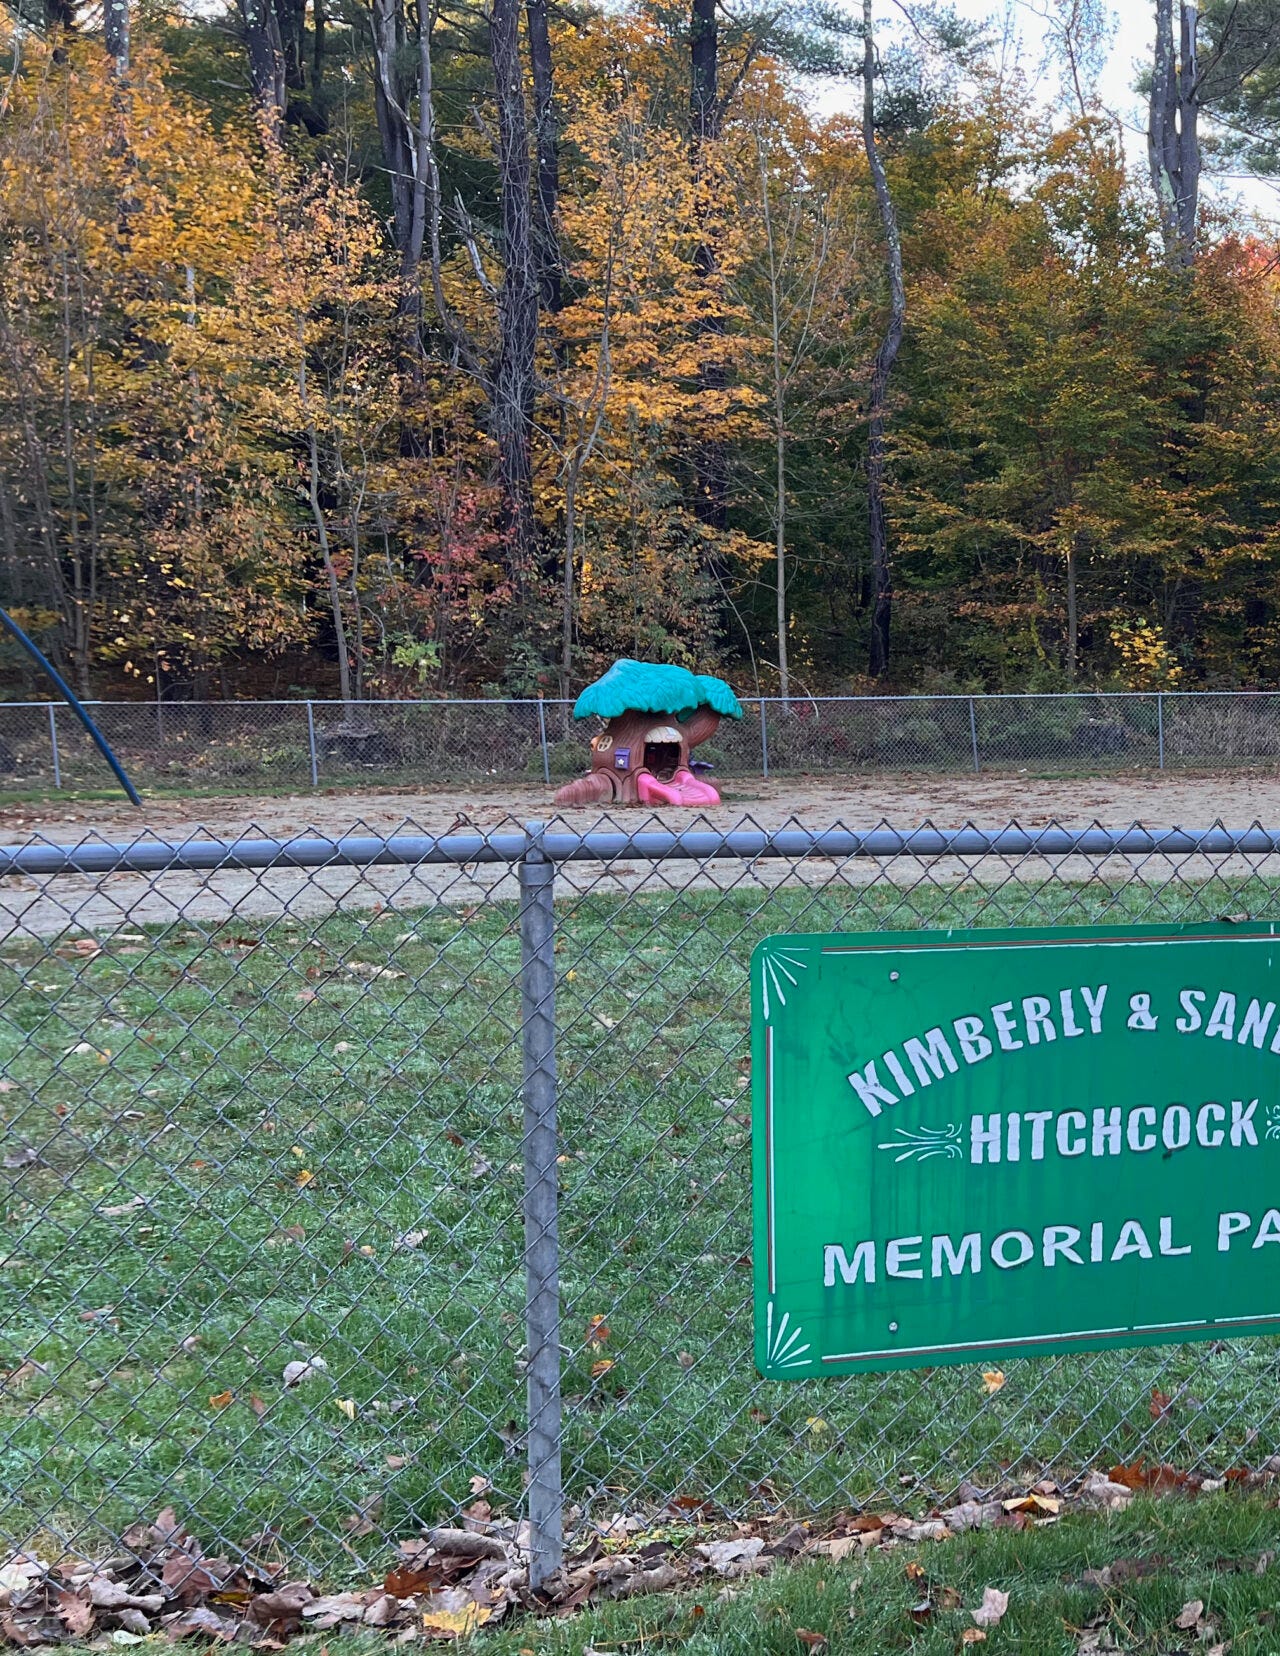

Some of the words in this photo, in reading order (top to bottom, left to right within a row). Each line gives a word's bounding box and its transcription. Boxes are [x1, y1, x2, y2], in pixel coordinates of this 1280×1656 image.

[847, 984, 1108, 1117] KIMBERLY
[1127, 993, 1159, 1031] &
[969, 1098, 1259, 1164] HITCHCOCK
[823, 1215, 1192, 1287] MEMORIAL
